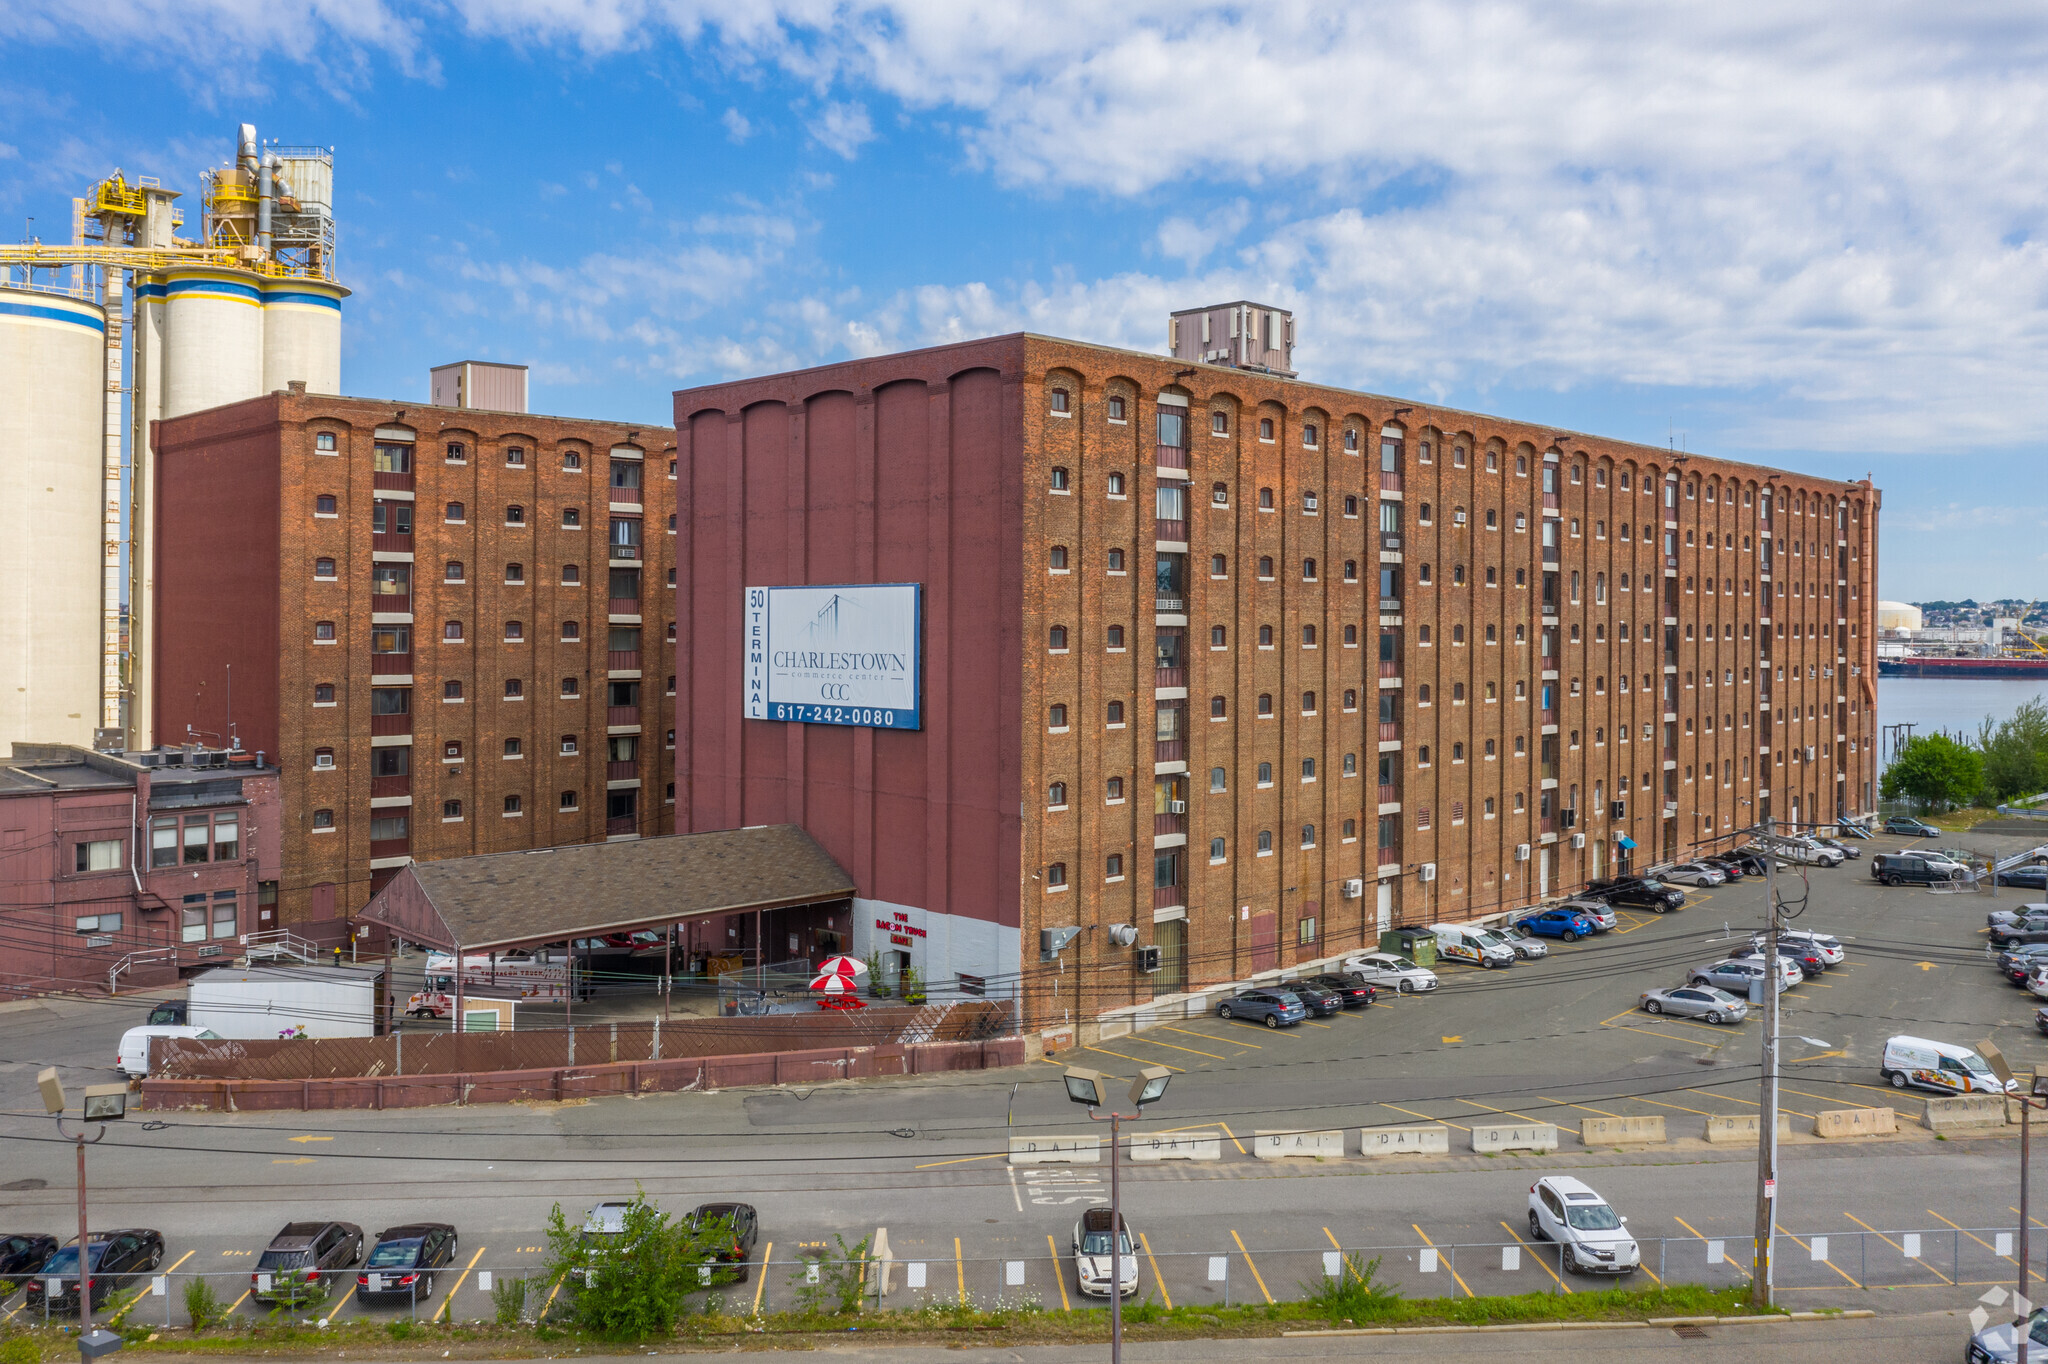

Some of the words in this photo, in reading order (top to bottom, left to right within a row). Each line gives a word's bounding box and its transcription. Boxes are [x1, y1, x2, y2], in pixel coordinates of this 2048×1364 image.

[750, 589, 764, 609] 50
[751, 612, 762, 717] TERMINAL
[774, 651, 906, 671] CHARLESTOWN
[791, 672, 843, 680] commerce
[849, 673, 885, 681] center
[821, 682, 850, 701] CCC
[777, 704, 894, 726] 617-242-0080
[893, 912, 908, 922] THE
[876, 919, 902, 932] BACON
[904, 926, 927, 938] TRUCK
